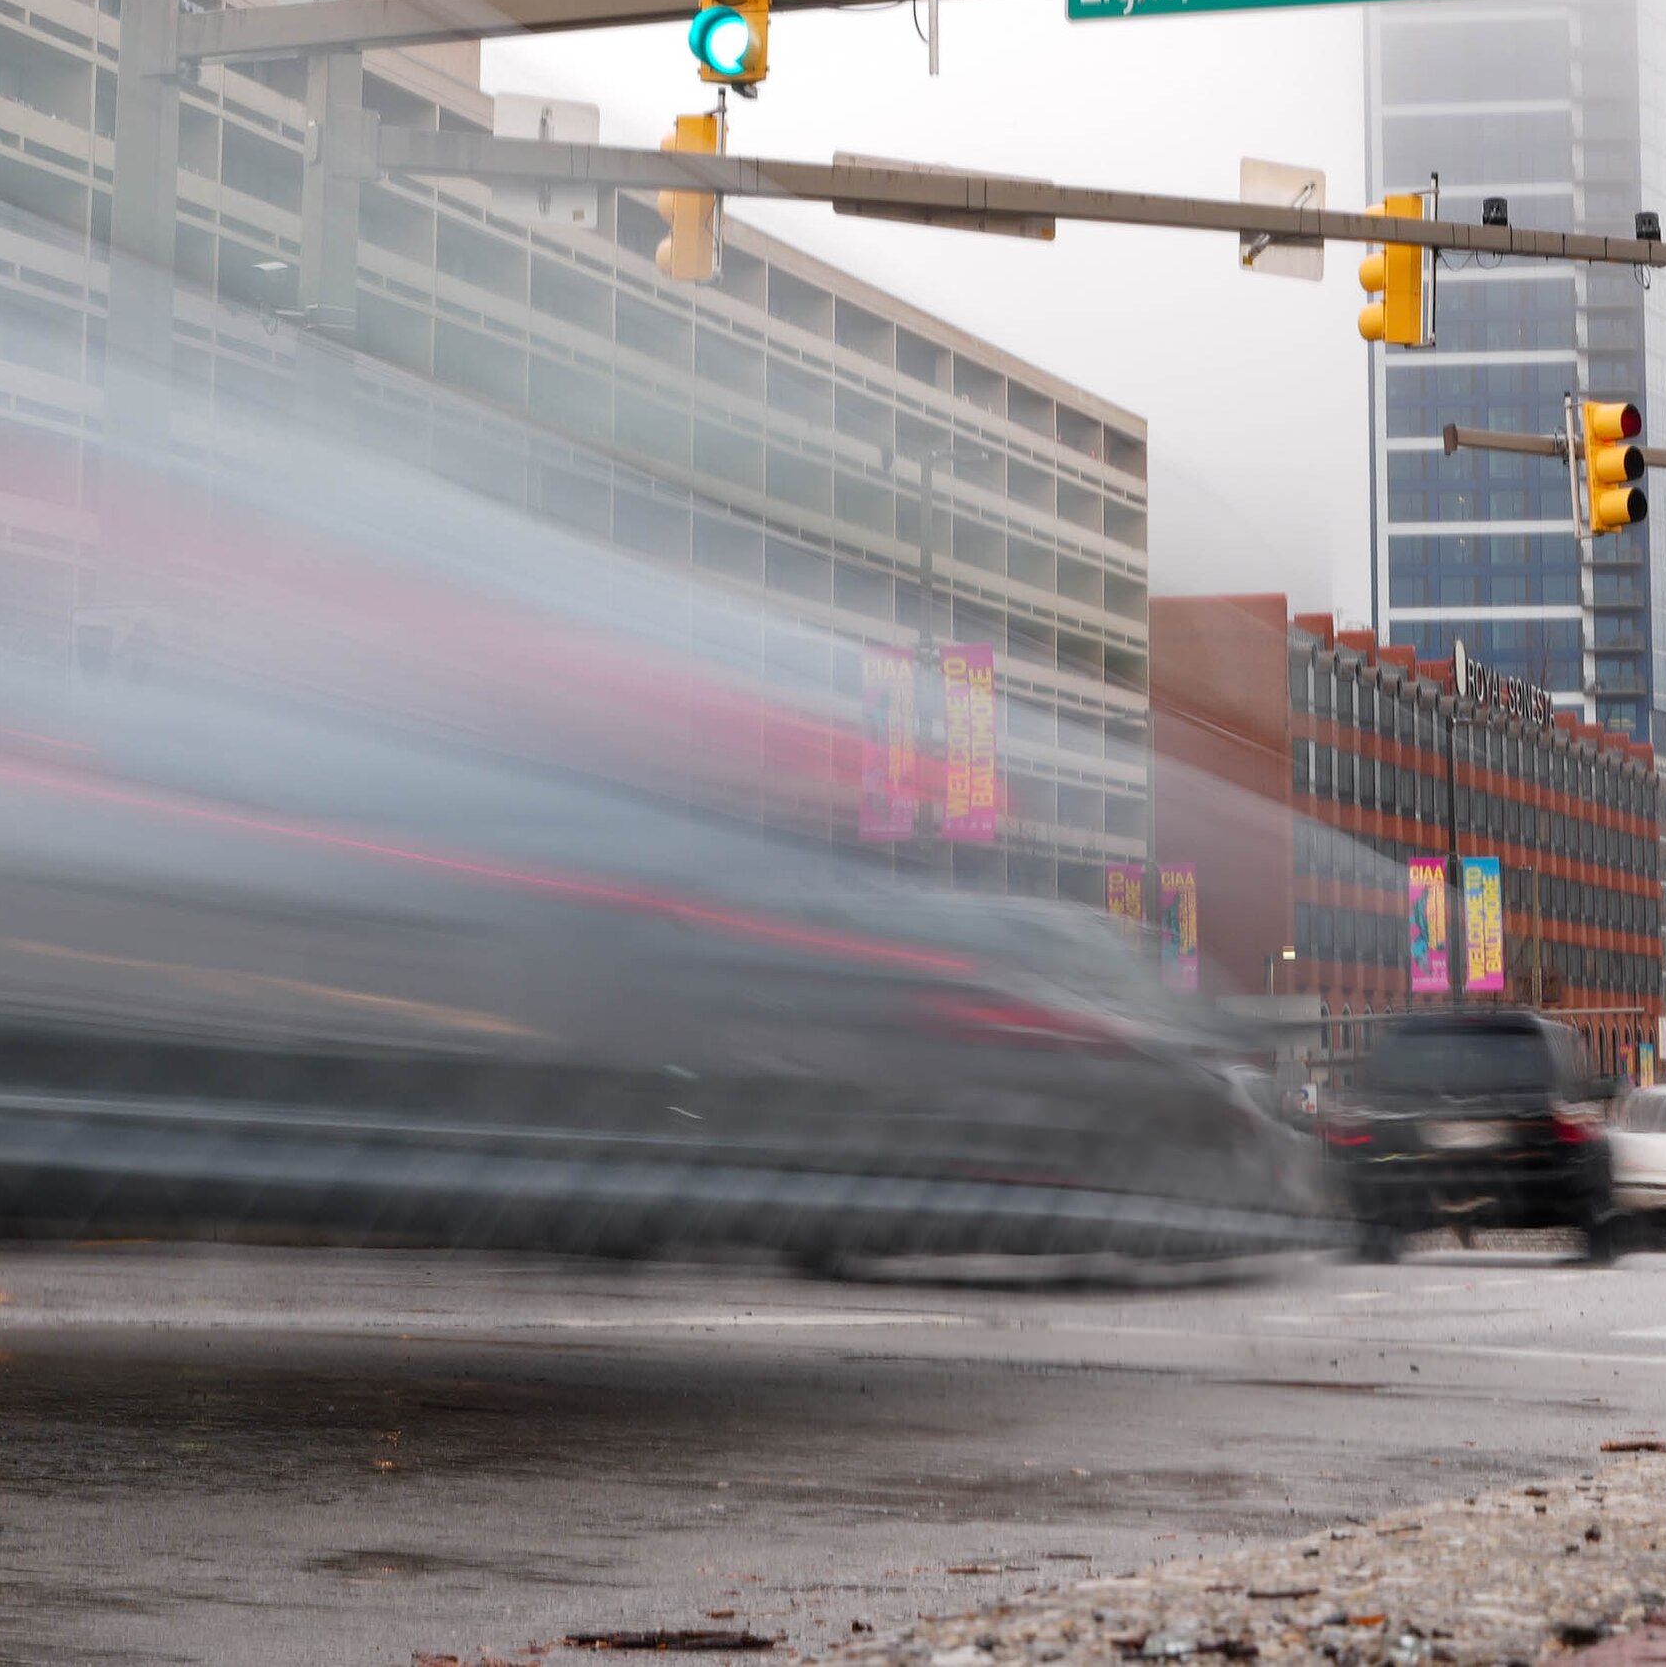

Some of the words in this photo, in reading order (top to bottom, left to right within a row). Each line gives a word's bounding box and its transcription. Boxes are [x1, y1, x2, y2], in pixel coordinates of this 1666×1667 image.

[943, 657, 967, 688] TO
[1467, 657, 1505, 710] ROYAL
[1508, 675, 1555, 731] SONESTA
[945, 696, 971, 819] WELCOME
[968, 667, 995, 808] BALTIMORE
[1161, 871, 1195, 887] CIAA
[1466, 866, 1482, 889] TO
[1468, 895, 1486, 981] WELCOME
[1483, 875, 1502, 972] BALTIMORE
